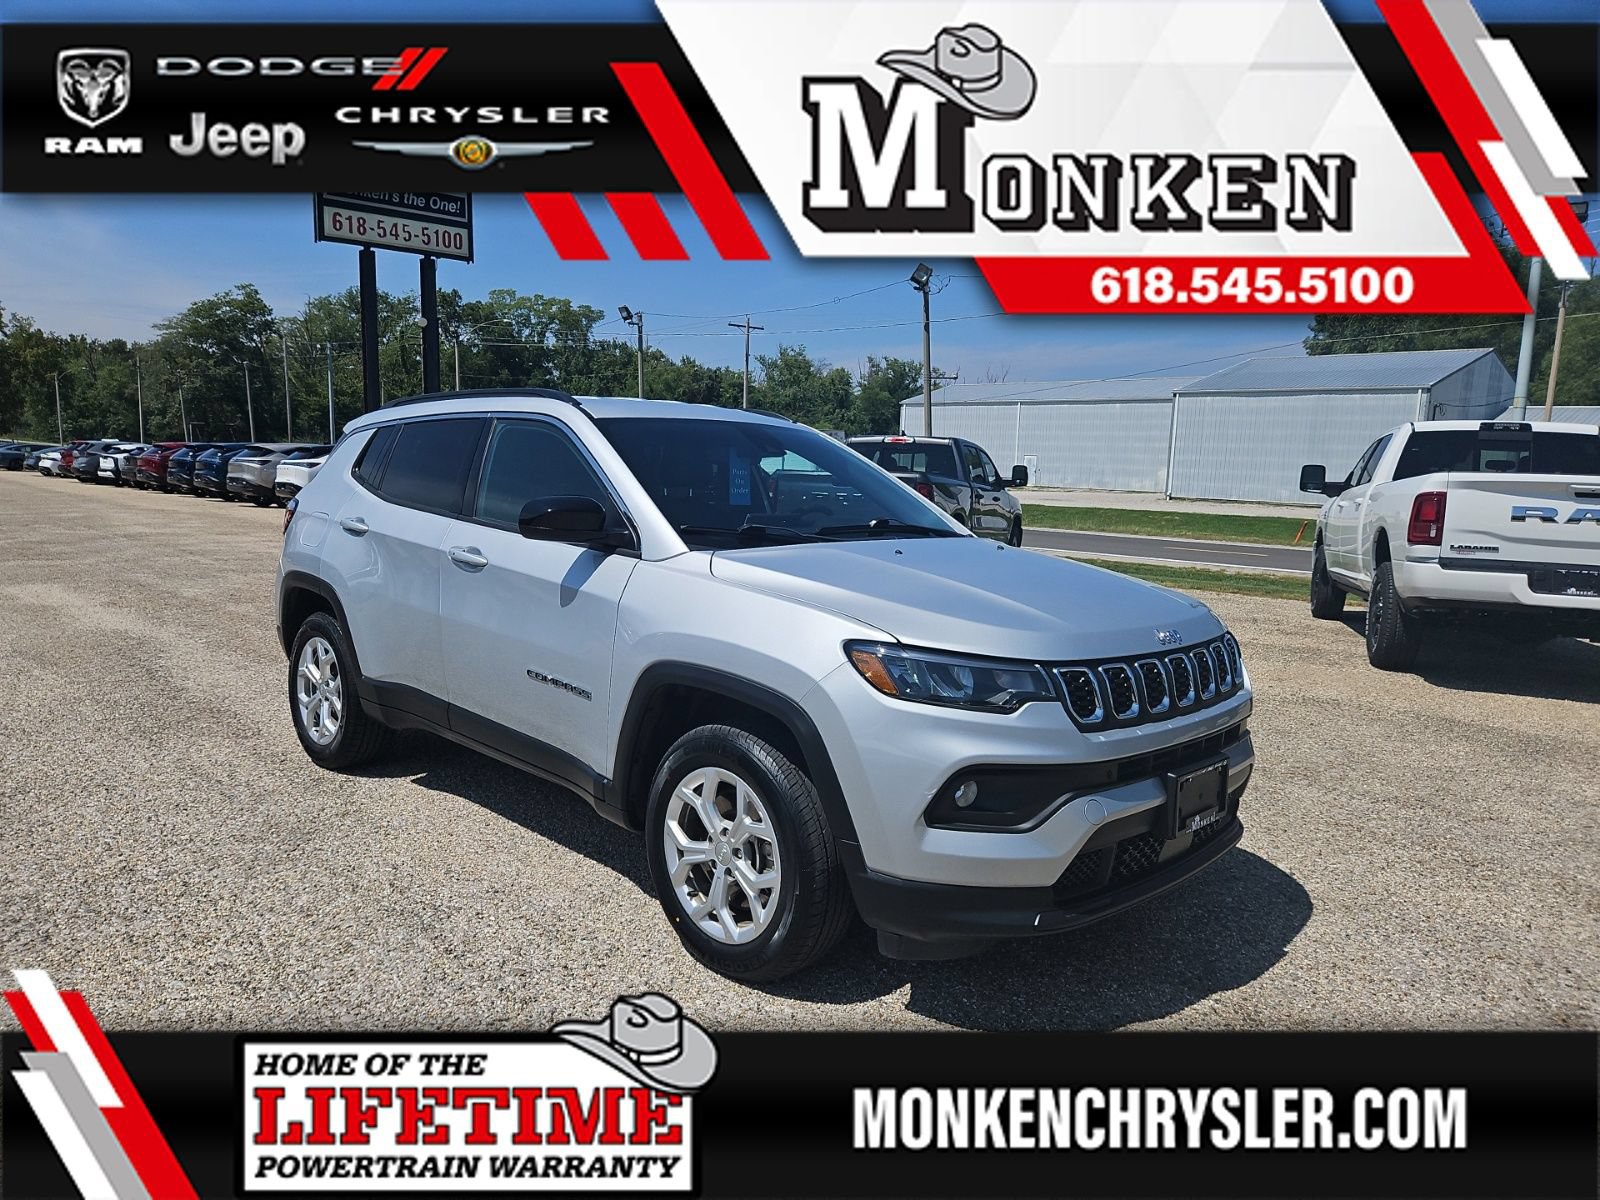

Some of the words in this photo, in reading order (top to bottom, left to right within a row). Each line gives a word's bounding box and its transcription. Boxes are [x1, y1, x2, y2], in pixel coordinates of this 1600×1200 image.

[404, 192, 426, 207] the
[430, 196, 461, 213] One!
[332, 211, 464, 250] 618-545-5100
[526, 669, 592, 701] COMPASS
